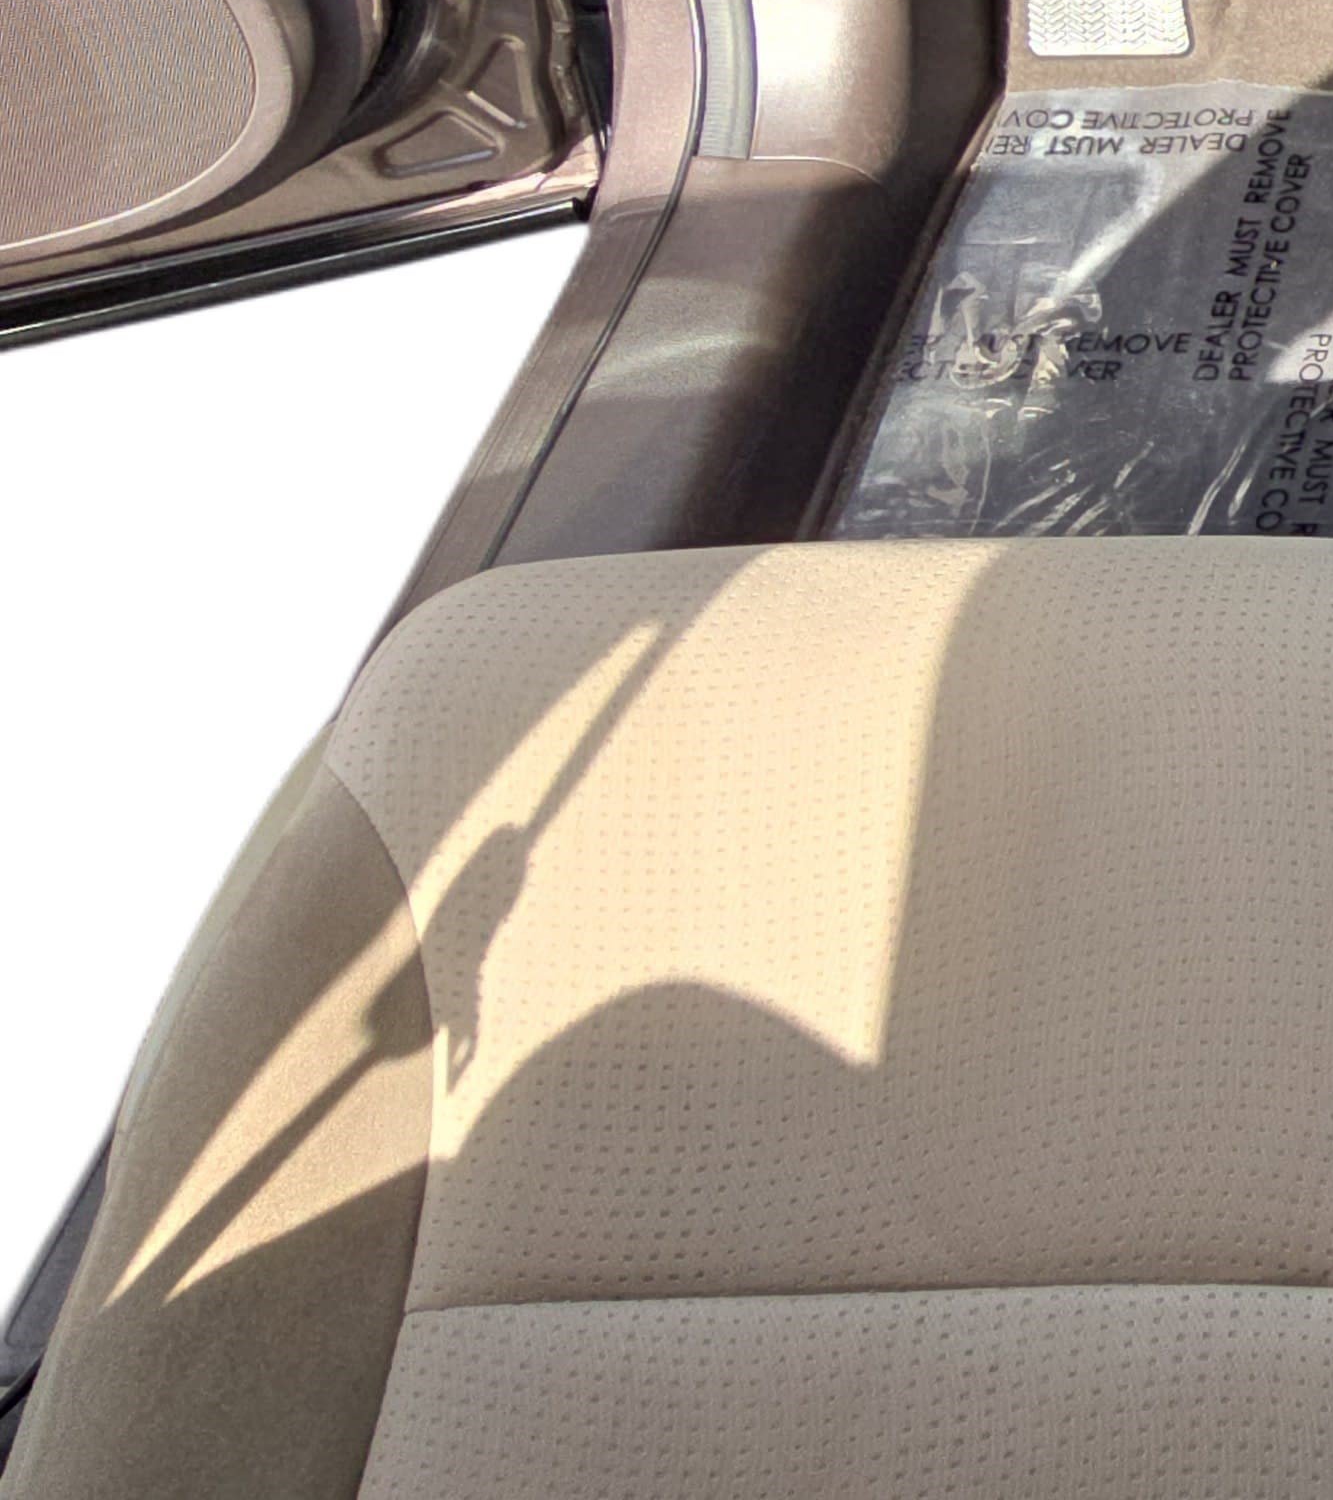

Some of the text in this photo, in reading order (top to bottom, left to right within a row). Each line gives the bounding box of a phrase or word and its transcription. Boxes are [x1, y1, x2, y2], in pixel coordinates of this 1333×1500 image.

[1045, 135, 1124, 156] MUST
[1082, 108, 1252, 130] PROTECTIVE
[1140, 133, 1248, 155] DEALER
[1193, 109, 1292, 381] DEALER MUST REMOVE
[1228, 154, 1313, 381] PROTECTIVE COVER
[1269, 334, 1333, 480] PROTECTIVE
